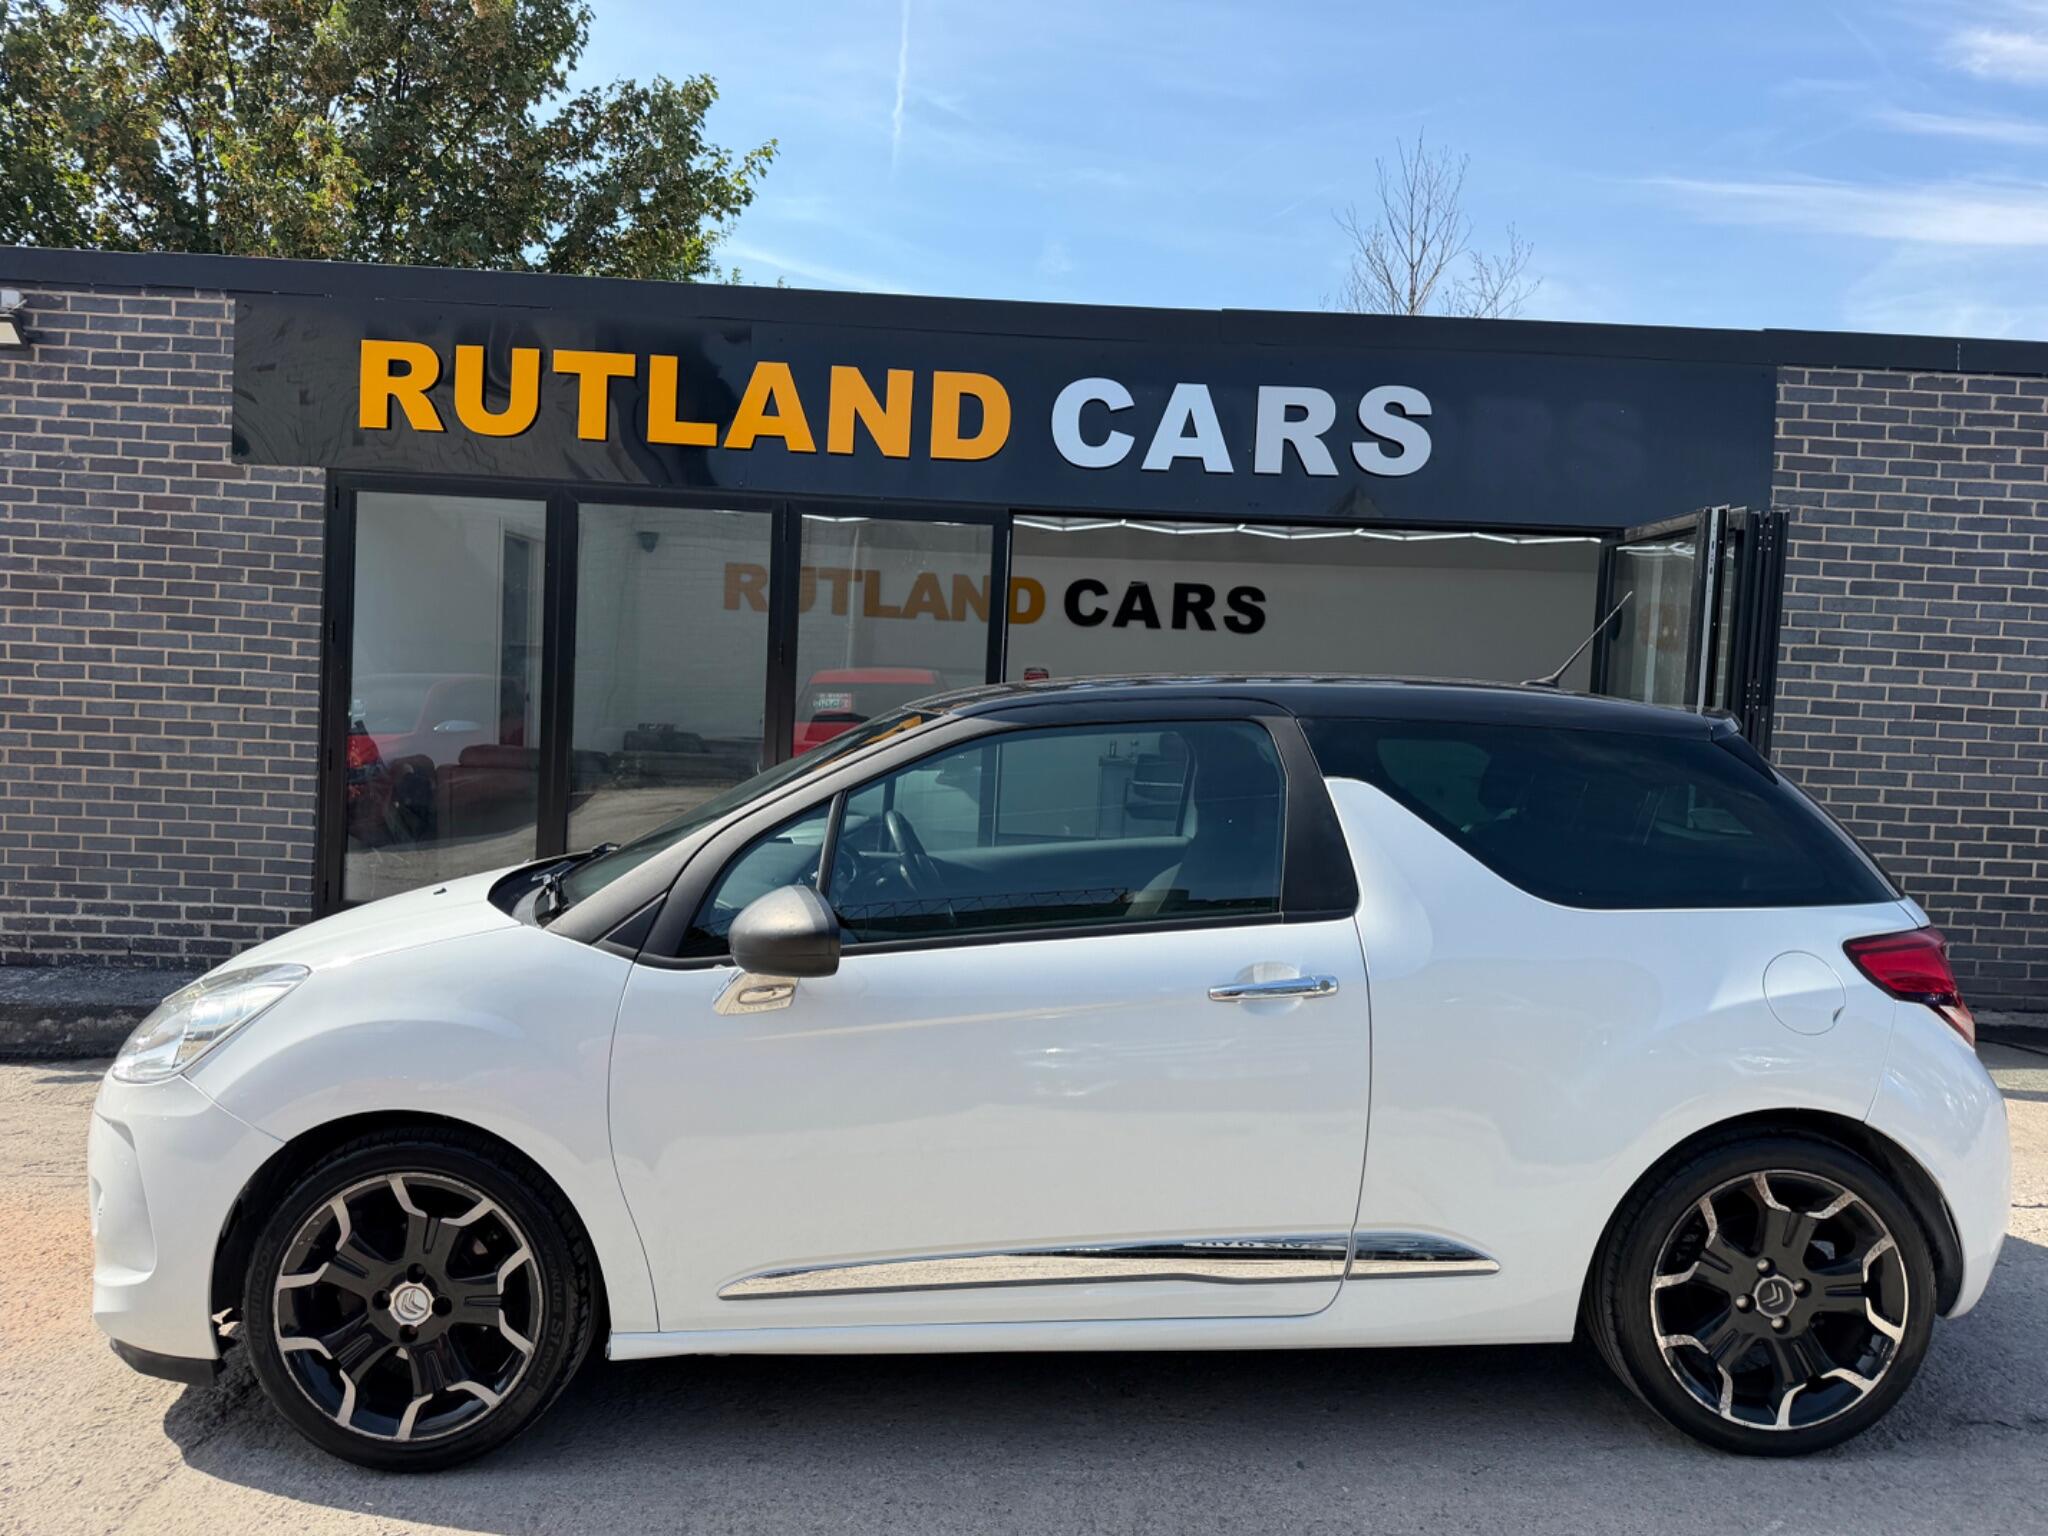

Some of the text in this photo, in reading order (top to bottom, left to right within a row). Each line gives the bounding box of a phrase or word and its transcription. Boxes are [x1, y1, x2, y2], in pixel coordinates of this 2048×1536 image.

[358, 339, 1012, 461] RUTLAND
[1051, 377, 1433, 476] CARS
[1064, 579, 1266, 634] CARS
